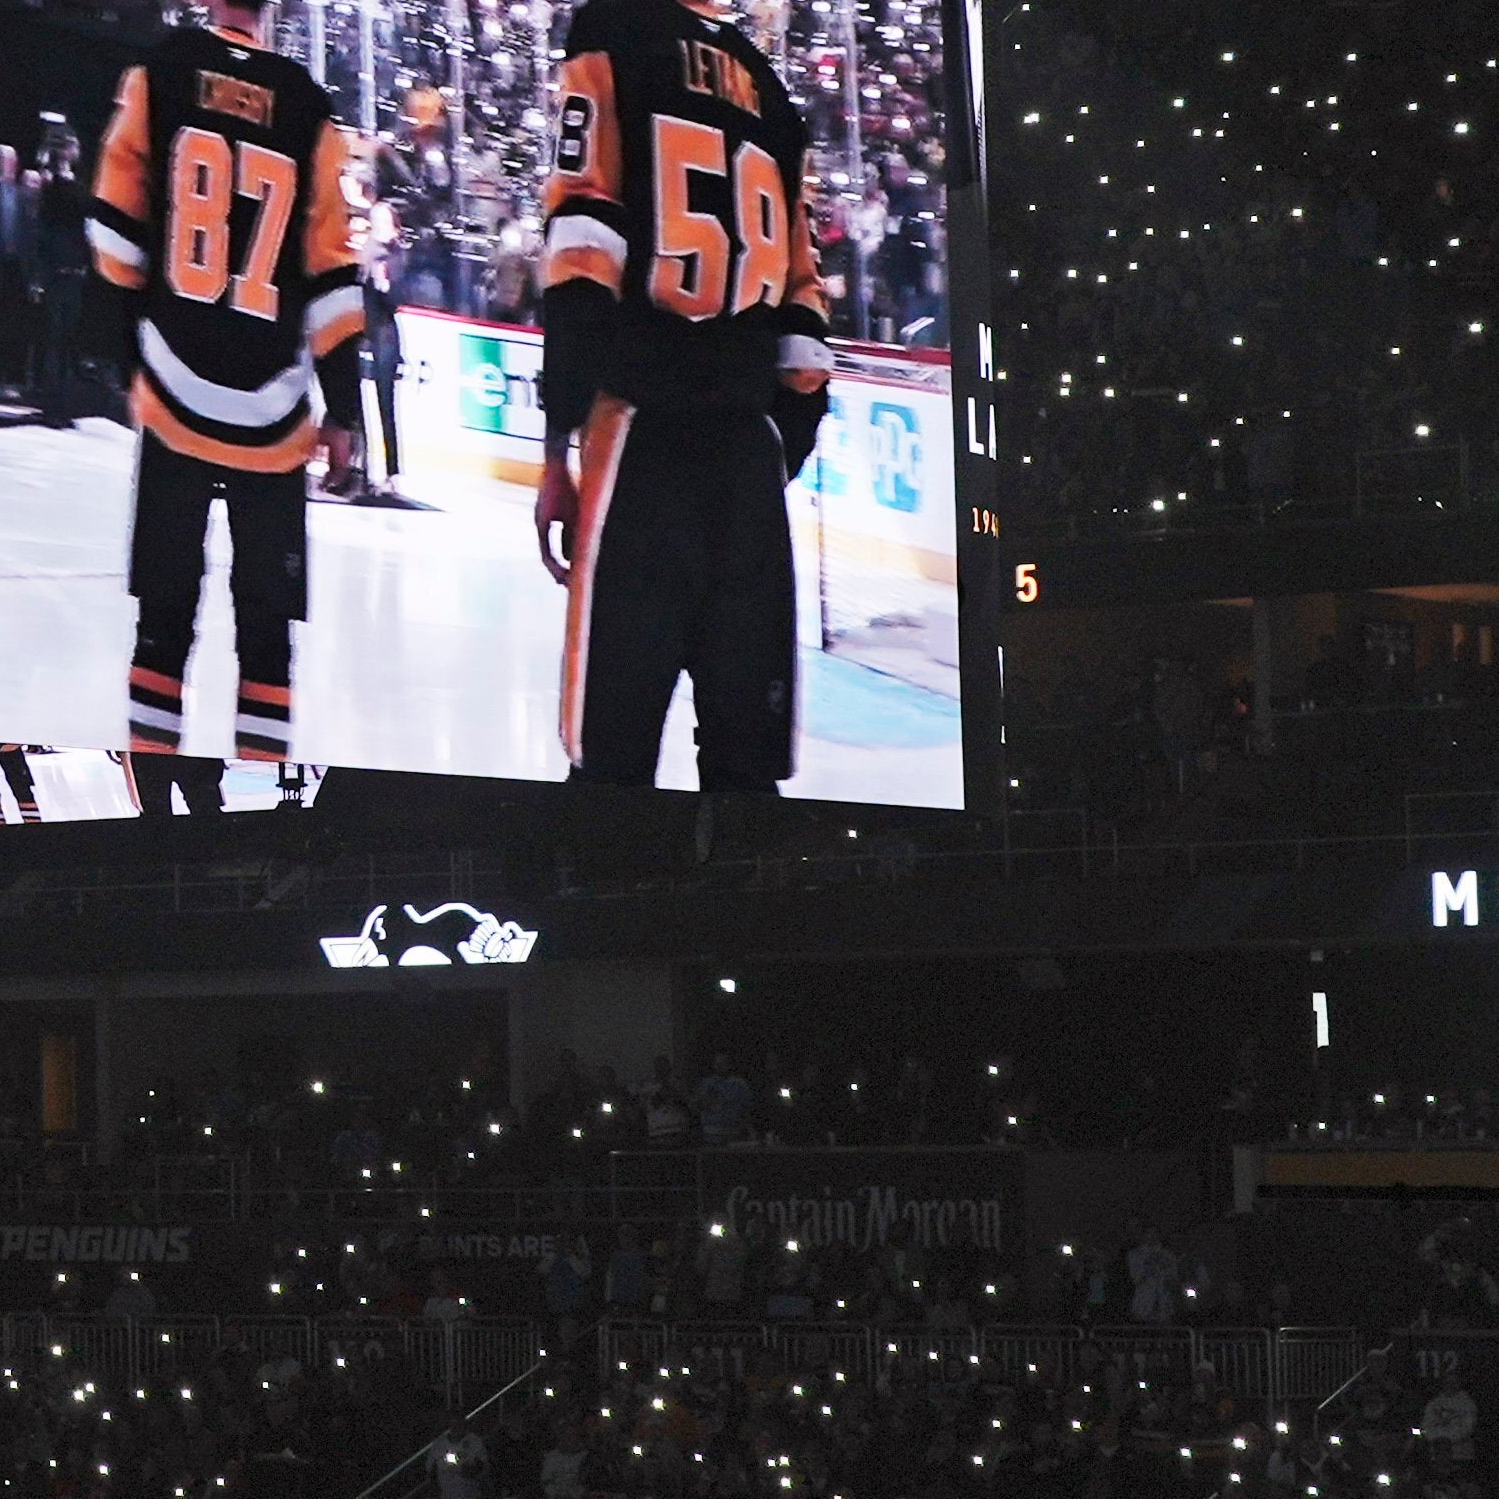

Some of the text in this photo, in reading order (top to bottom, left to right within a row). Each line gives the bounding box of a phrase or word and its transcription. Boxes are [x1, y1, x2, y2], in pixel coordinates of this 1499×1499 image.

[164, 125, 298, 323] 87
[649, 113, 791, 323] 58
[0, 1226, 192, 1264] PENGUINS
